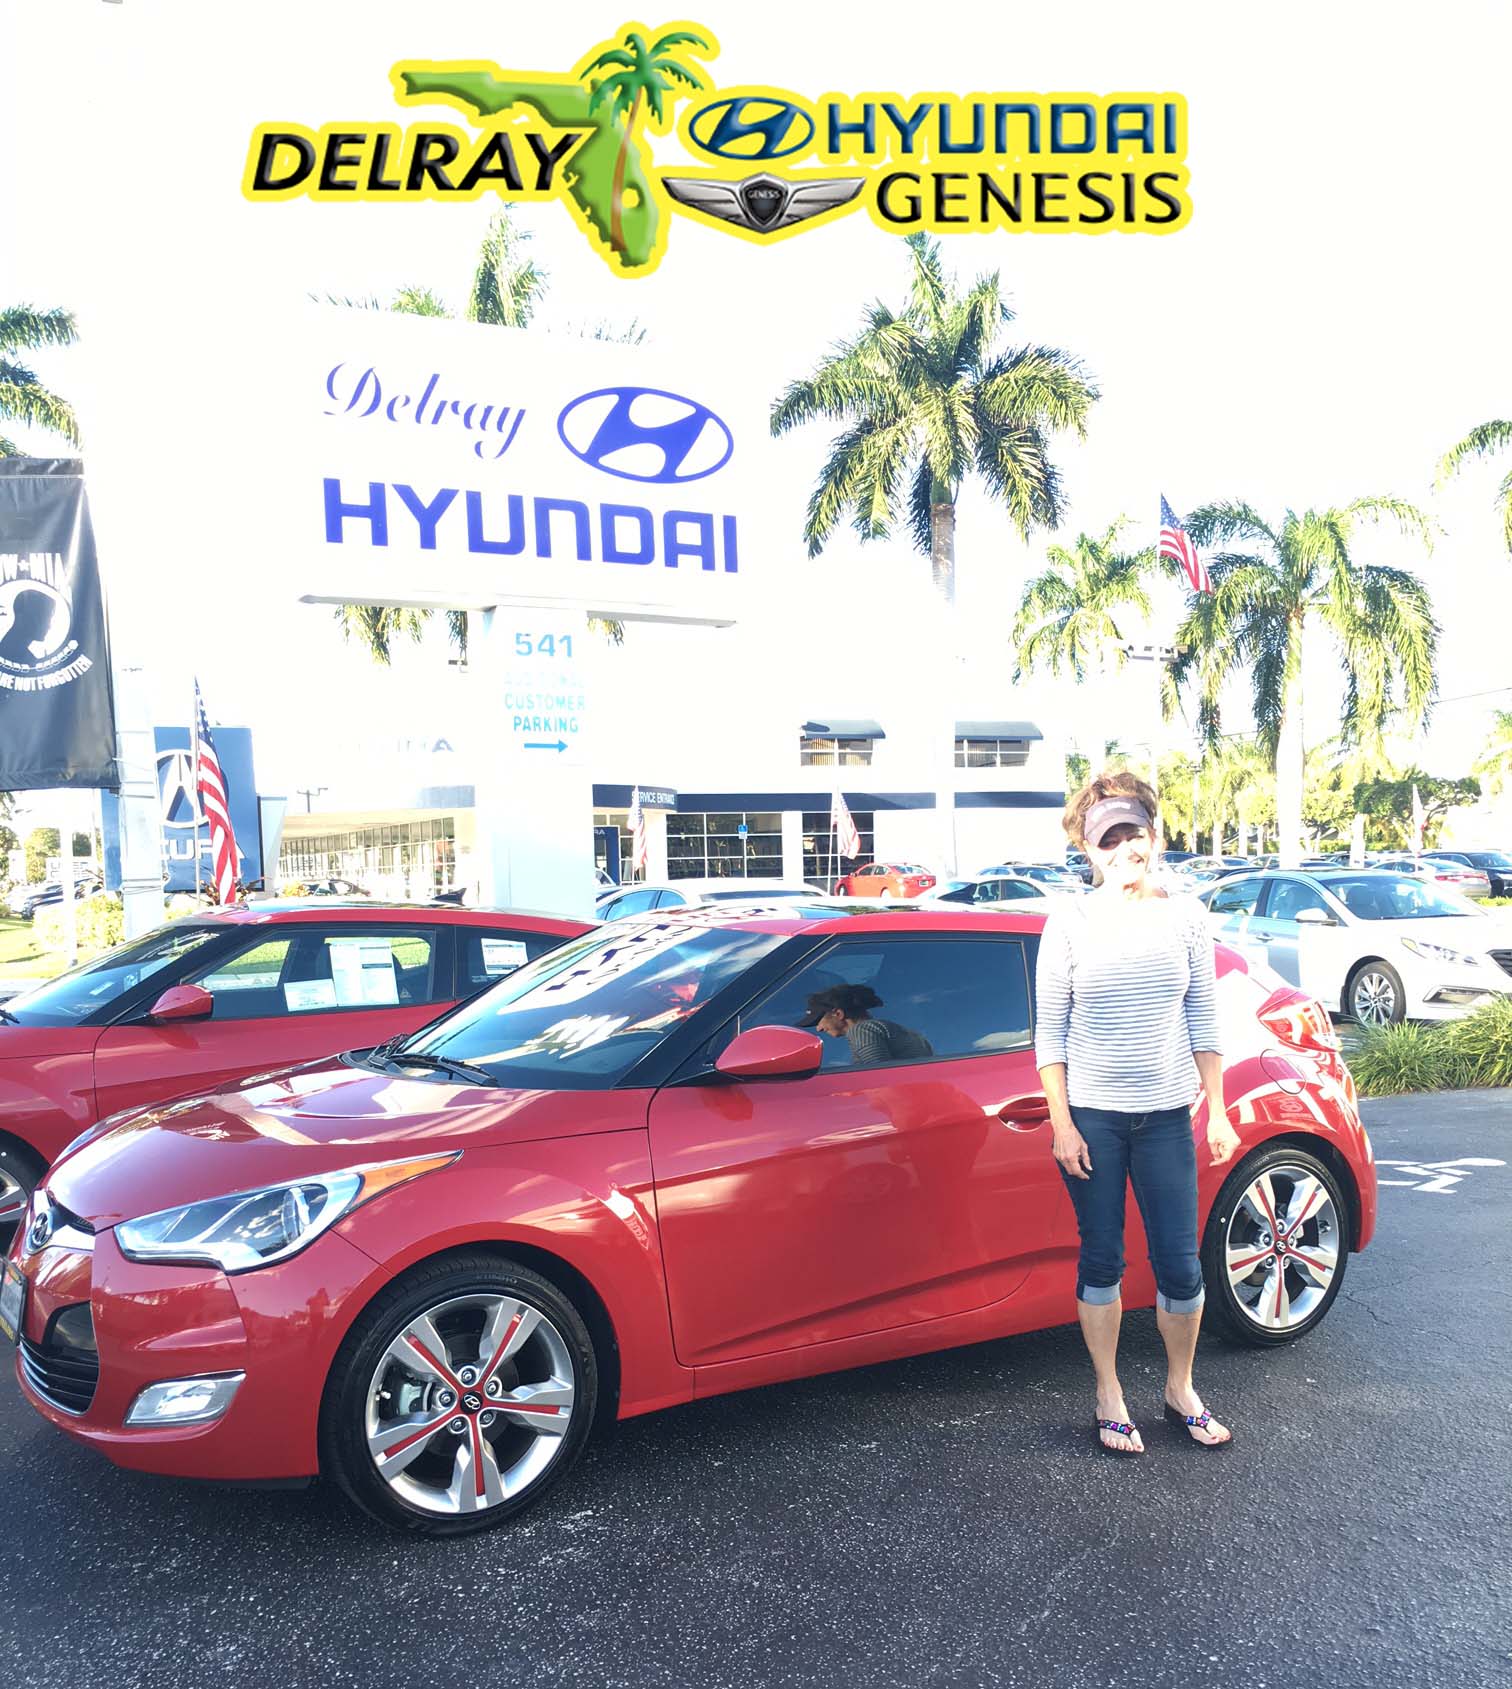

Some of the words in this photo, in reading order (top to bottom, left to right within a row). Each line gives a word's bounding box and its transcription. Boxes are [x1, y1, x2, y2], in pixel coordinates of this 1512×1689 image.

[322, 362, 527, 460] Delray
[323, 477, 738, 574] HYUNDAI
[514, 632, 573, 658] 541
[504, 693, 586, 711] CUSTOMER
[512, 715, 579, 733] PARKING
